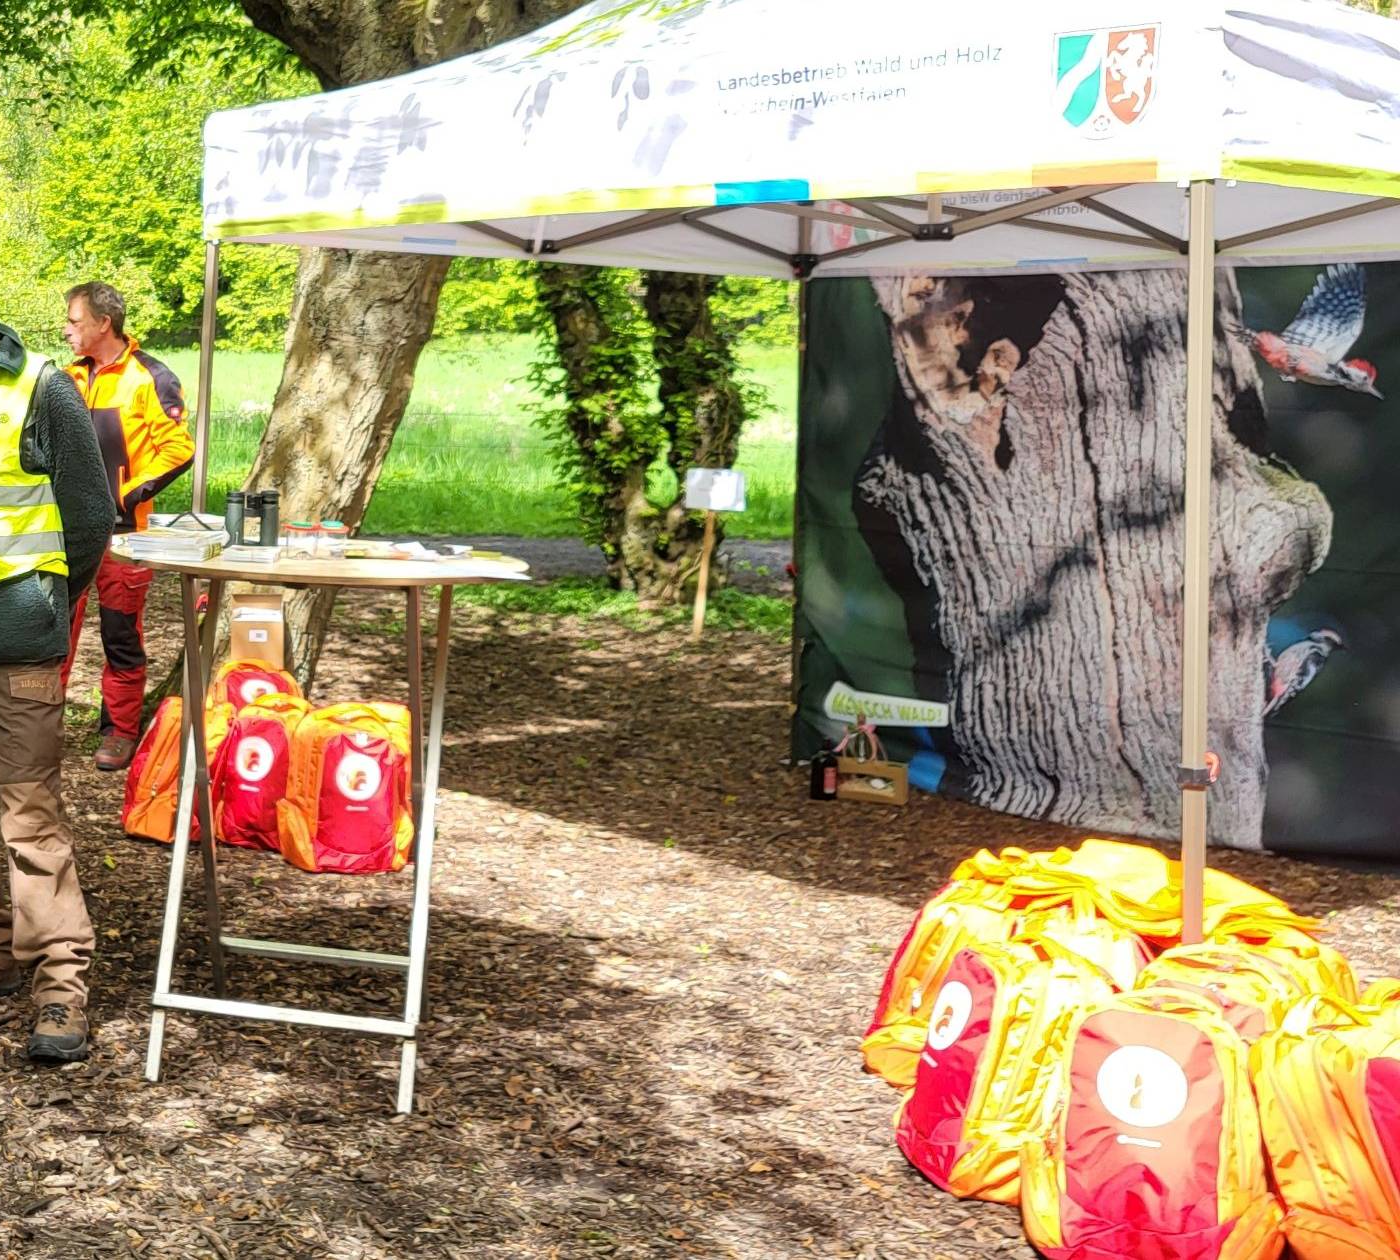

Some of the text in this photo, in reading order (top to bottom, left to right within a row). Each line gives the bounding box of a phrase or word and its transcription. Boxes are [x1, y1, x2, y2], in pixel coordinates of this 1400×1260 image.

[717, 44, 1003, 91] Landesbetrieb Wald und Holz
